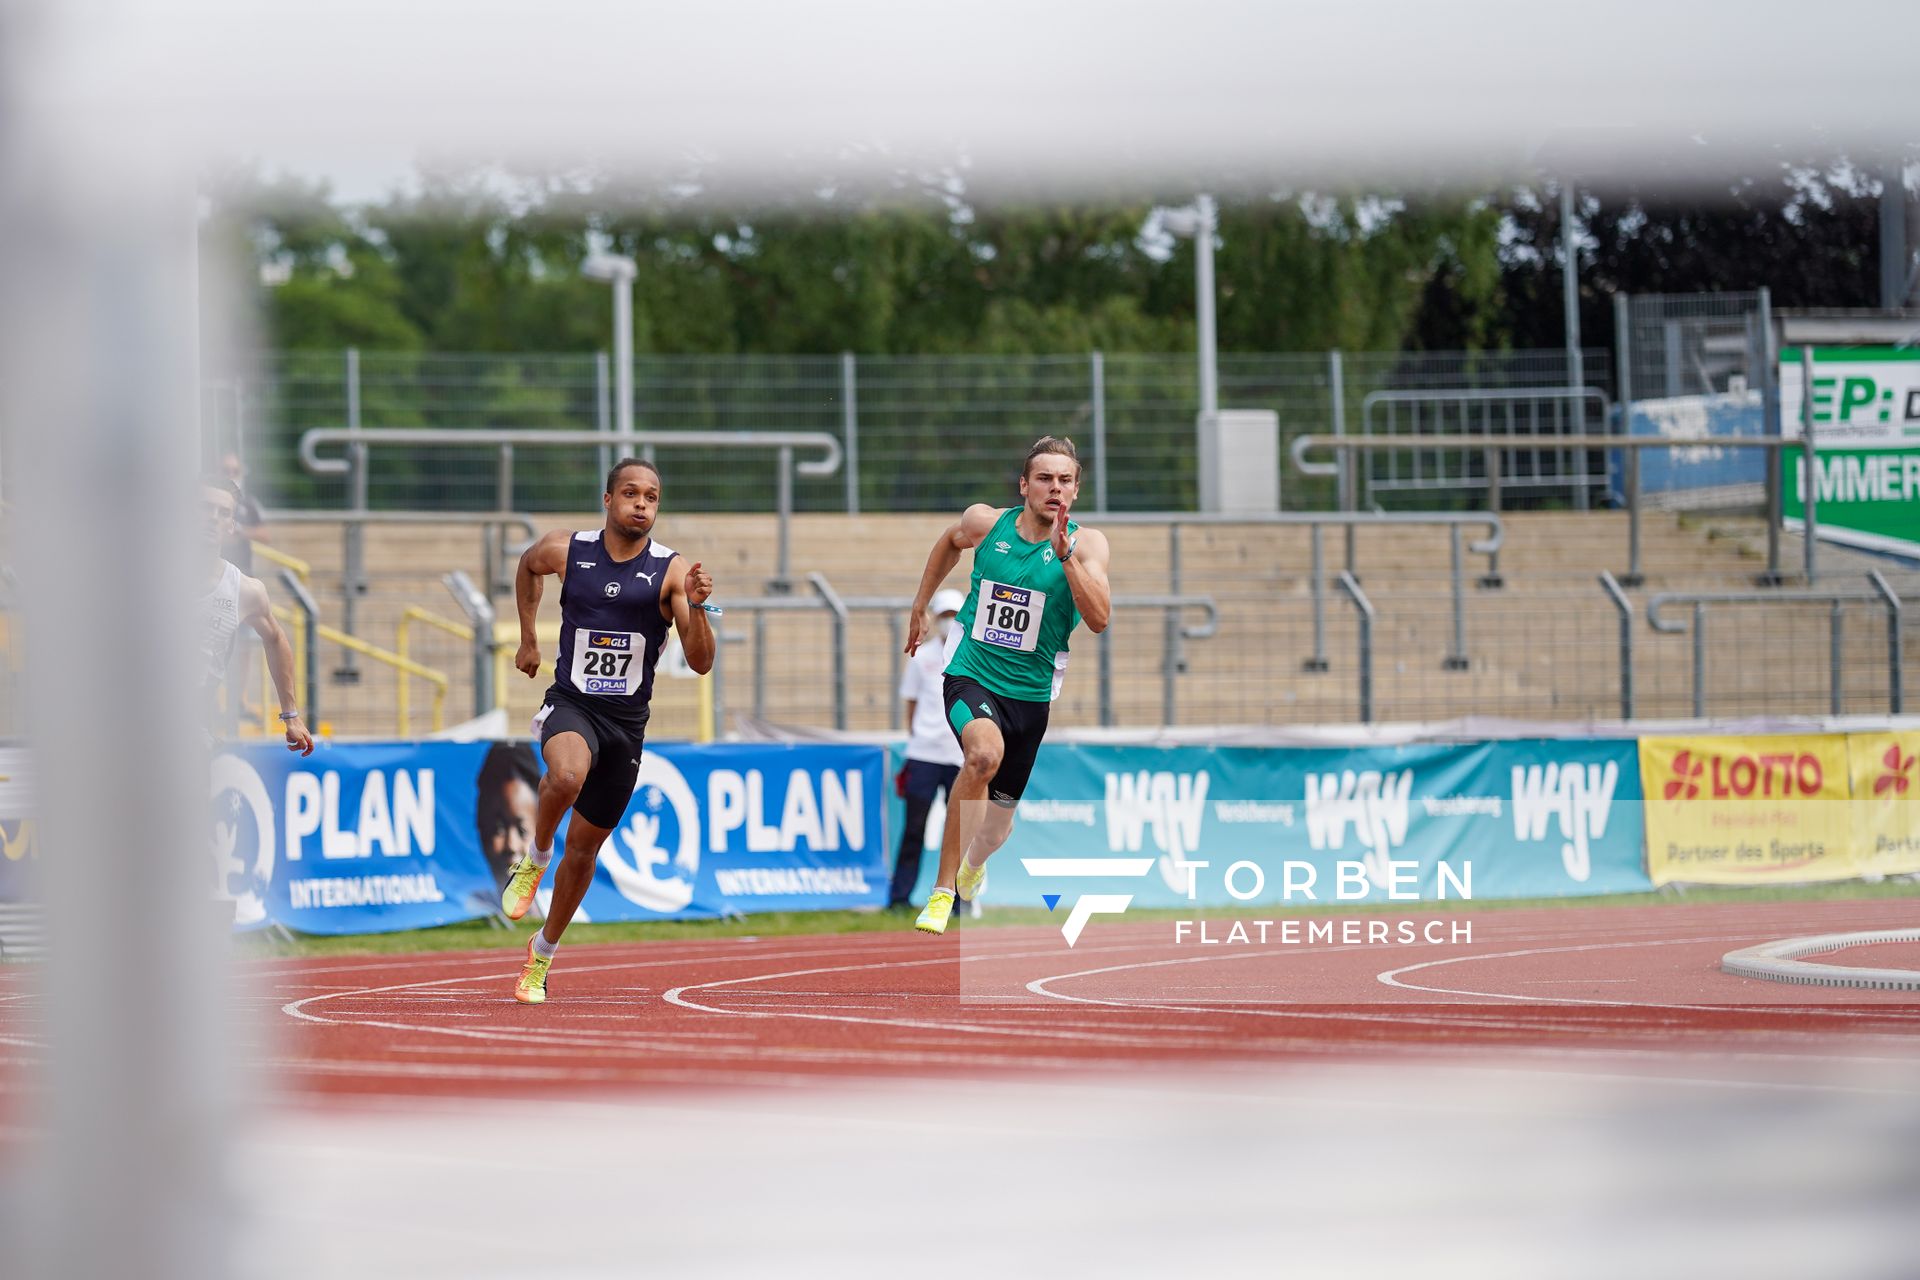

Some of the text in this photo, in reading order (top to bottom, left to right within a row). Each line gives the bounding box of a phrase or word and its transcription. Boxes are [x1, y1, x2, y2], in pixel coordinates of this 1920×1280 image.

[1799, 377, 1894, 421] EP:
[1011, 592, 1028, 603] GLS
[986, 602, 1030, 633] 180
[610, 637, 628, 648] GLS
[998, 633, 1021, 643] PLAN
[583, 651, 633, 677] 287
[602, 681, 626, 689] PLAN
[1711, 752, 1823, 798] LOTTO
[285, 768, 436, 861] PLAN
[707, 768, 865, 853] PLAN
[1667, 838, 1825, 865] Partner des Sports
[289, 873, 445, 910] INTERNATIONAL
[714, 866, 872, 897] INTERNATIONAL
